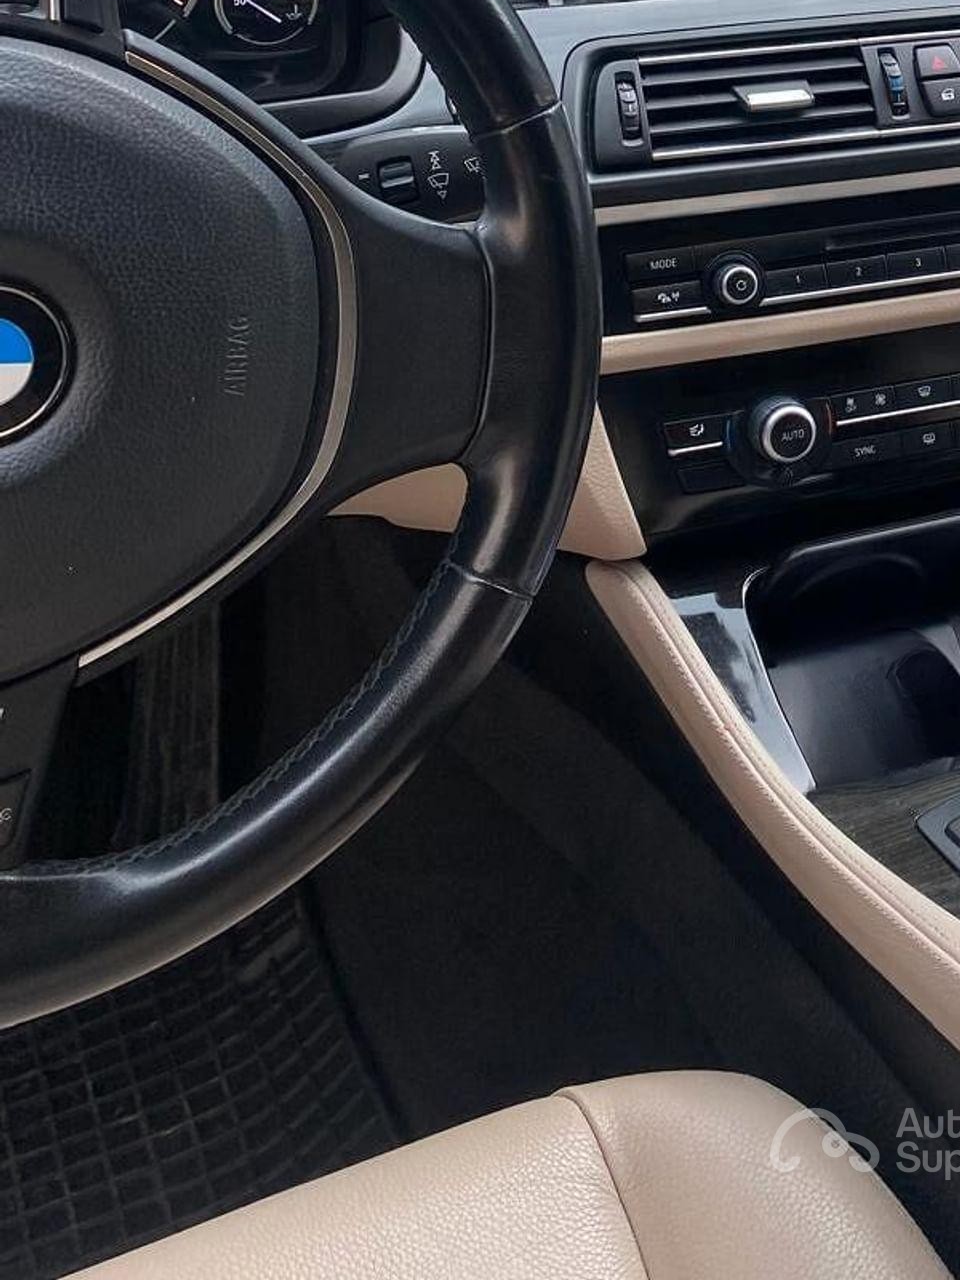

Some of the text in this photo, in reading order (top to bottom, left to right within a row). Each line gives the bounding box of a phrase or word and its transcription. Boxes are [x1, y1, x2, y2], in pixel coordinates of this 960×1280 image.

[650, 257, 678, 269] MODE
[222, 315, 250, 397] AIRBAG
[781, 428, 806, 443] AUTO
[854, 445, 877, 458] SYNC
